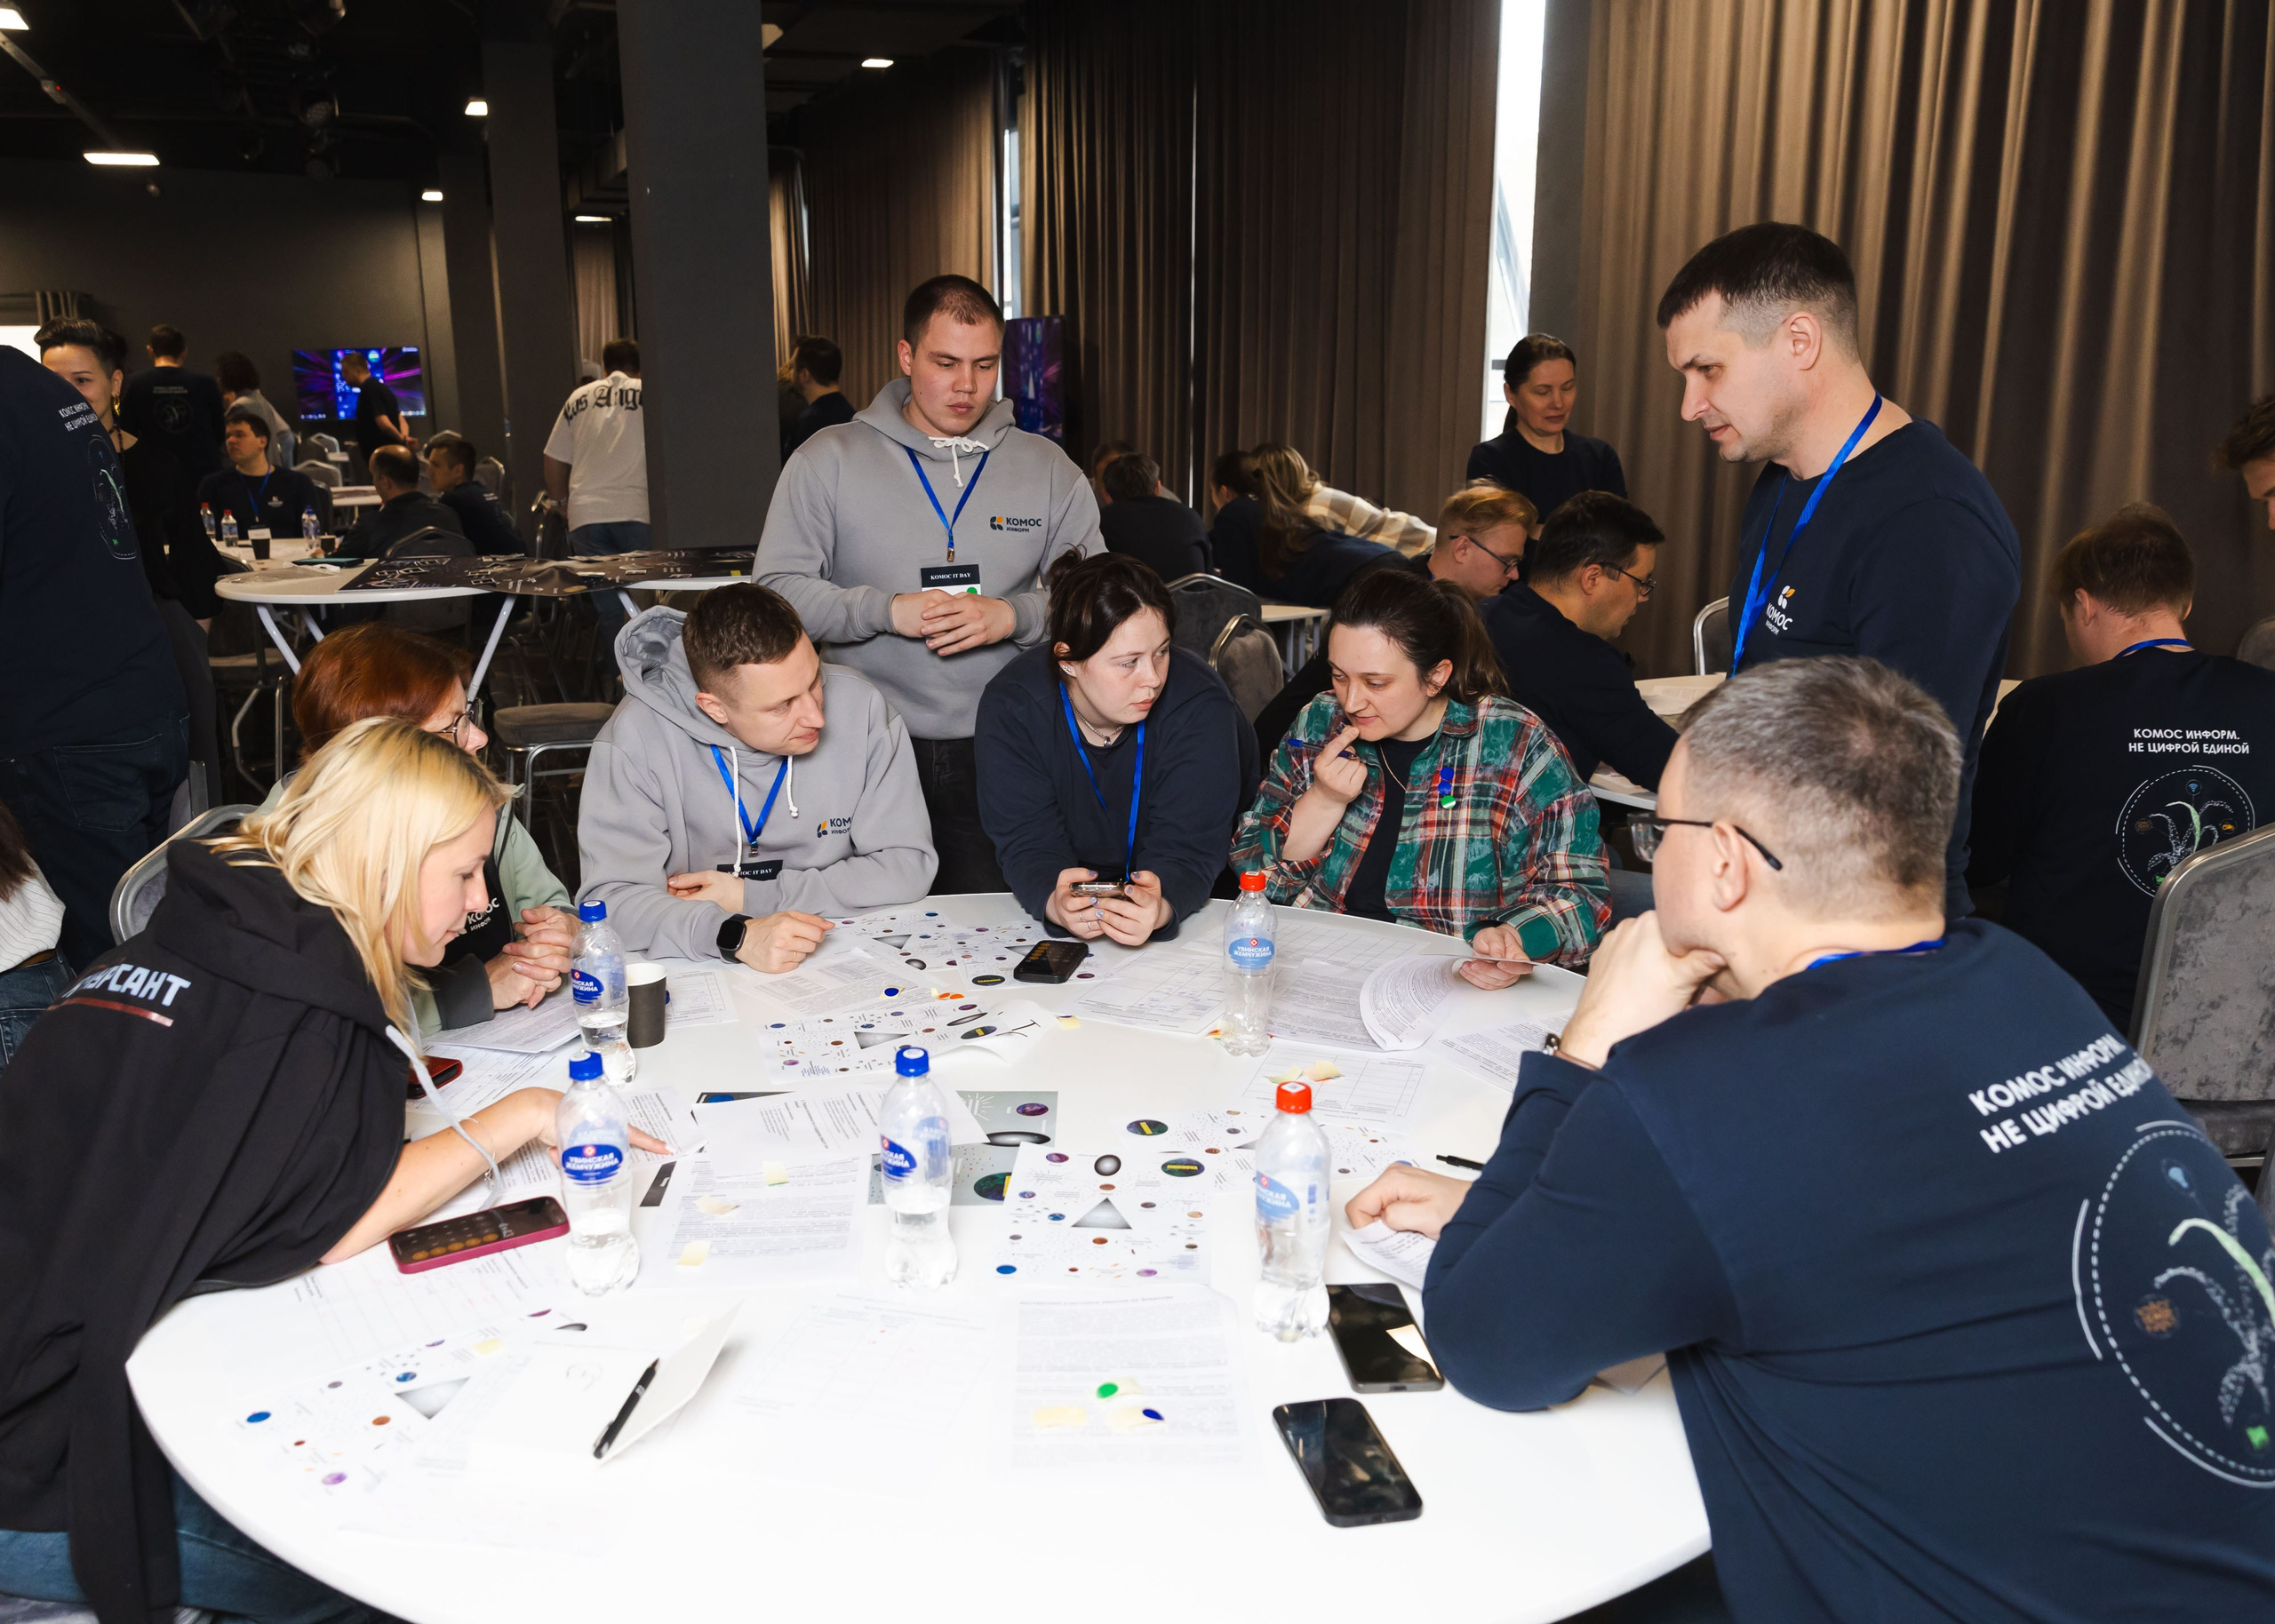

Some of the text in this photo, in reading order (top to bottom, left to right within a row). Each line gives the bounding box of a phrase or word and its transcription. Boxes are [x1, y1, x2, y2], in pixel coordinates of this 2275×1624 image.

[1006, 517, 1042, 527] КОМОС
[1766, 602, 1793, 631] КОМОС
[2134, 728, 2240, 740] КОМОС ИНФОРМ.
[2128, 742, 2249, 754] НЕ ЦИФРОЙ ЕДИНОЙ
[467, 897, 499, 924] КООС
[1968, 1065, 2067, 1117] КОМОС
[1979, 1118, 2028, 1154] НЕ
[2020, 1078, 2118, 1136] ЦИФРОЙ
[569, 1152, 614, 1163] УВИНСКАЯ
[566, 1158, 619, 1170] ЖЕМЧУЖИНА
